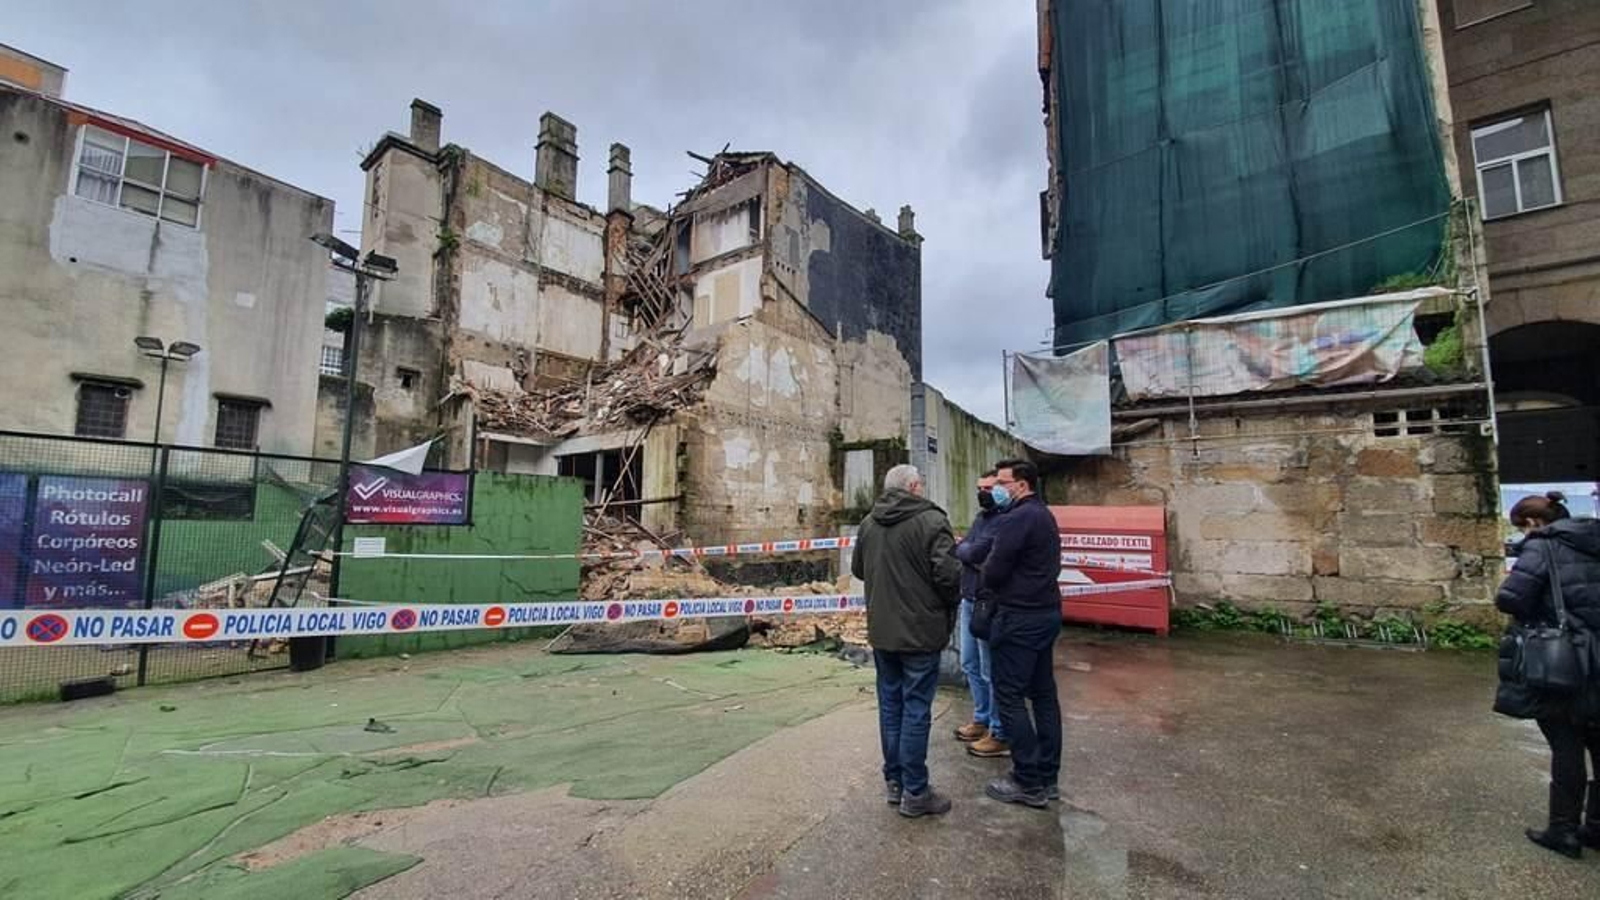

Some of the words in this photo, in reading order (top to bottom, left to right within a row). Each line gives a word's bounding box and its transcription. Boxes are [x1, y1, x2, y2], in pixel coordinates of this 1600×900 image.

[43, 485, 143, 502] Photocall
[50, 509, 131, 526] Rótulos
[353, 505, 462, 515] www.visualgraphics.es
[38, 533, 138, 552] Corpóreos
[34, 557, 136, 574] Neón-Led
[44, 586, 57, 600] y
[63, 580, 126, 597] más...
[74, 616, 105, 638] NO
[110, 616, 175, 638] PASAR
[224, 613, 292, 635] POLICIA
[297, 612, 346, 632] LOCAL
[352, 611, 387, 630] VIGO
[419, 609, 438, 626] NO
[441, 609, 480, 626] PASAR
[507, 607, 548, 623] POLICIA
[550, 605, 580, 620] LOCAL
[583, 605, 604, 619] VIGO
[624, 603, 636, 617] NO
[637, 601, 661, 617] PASAR
